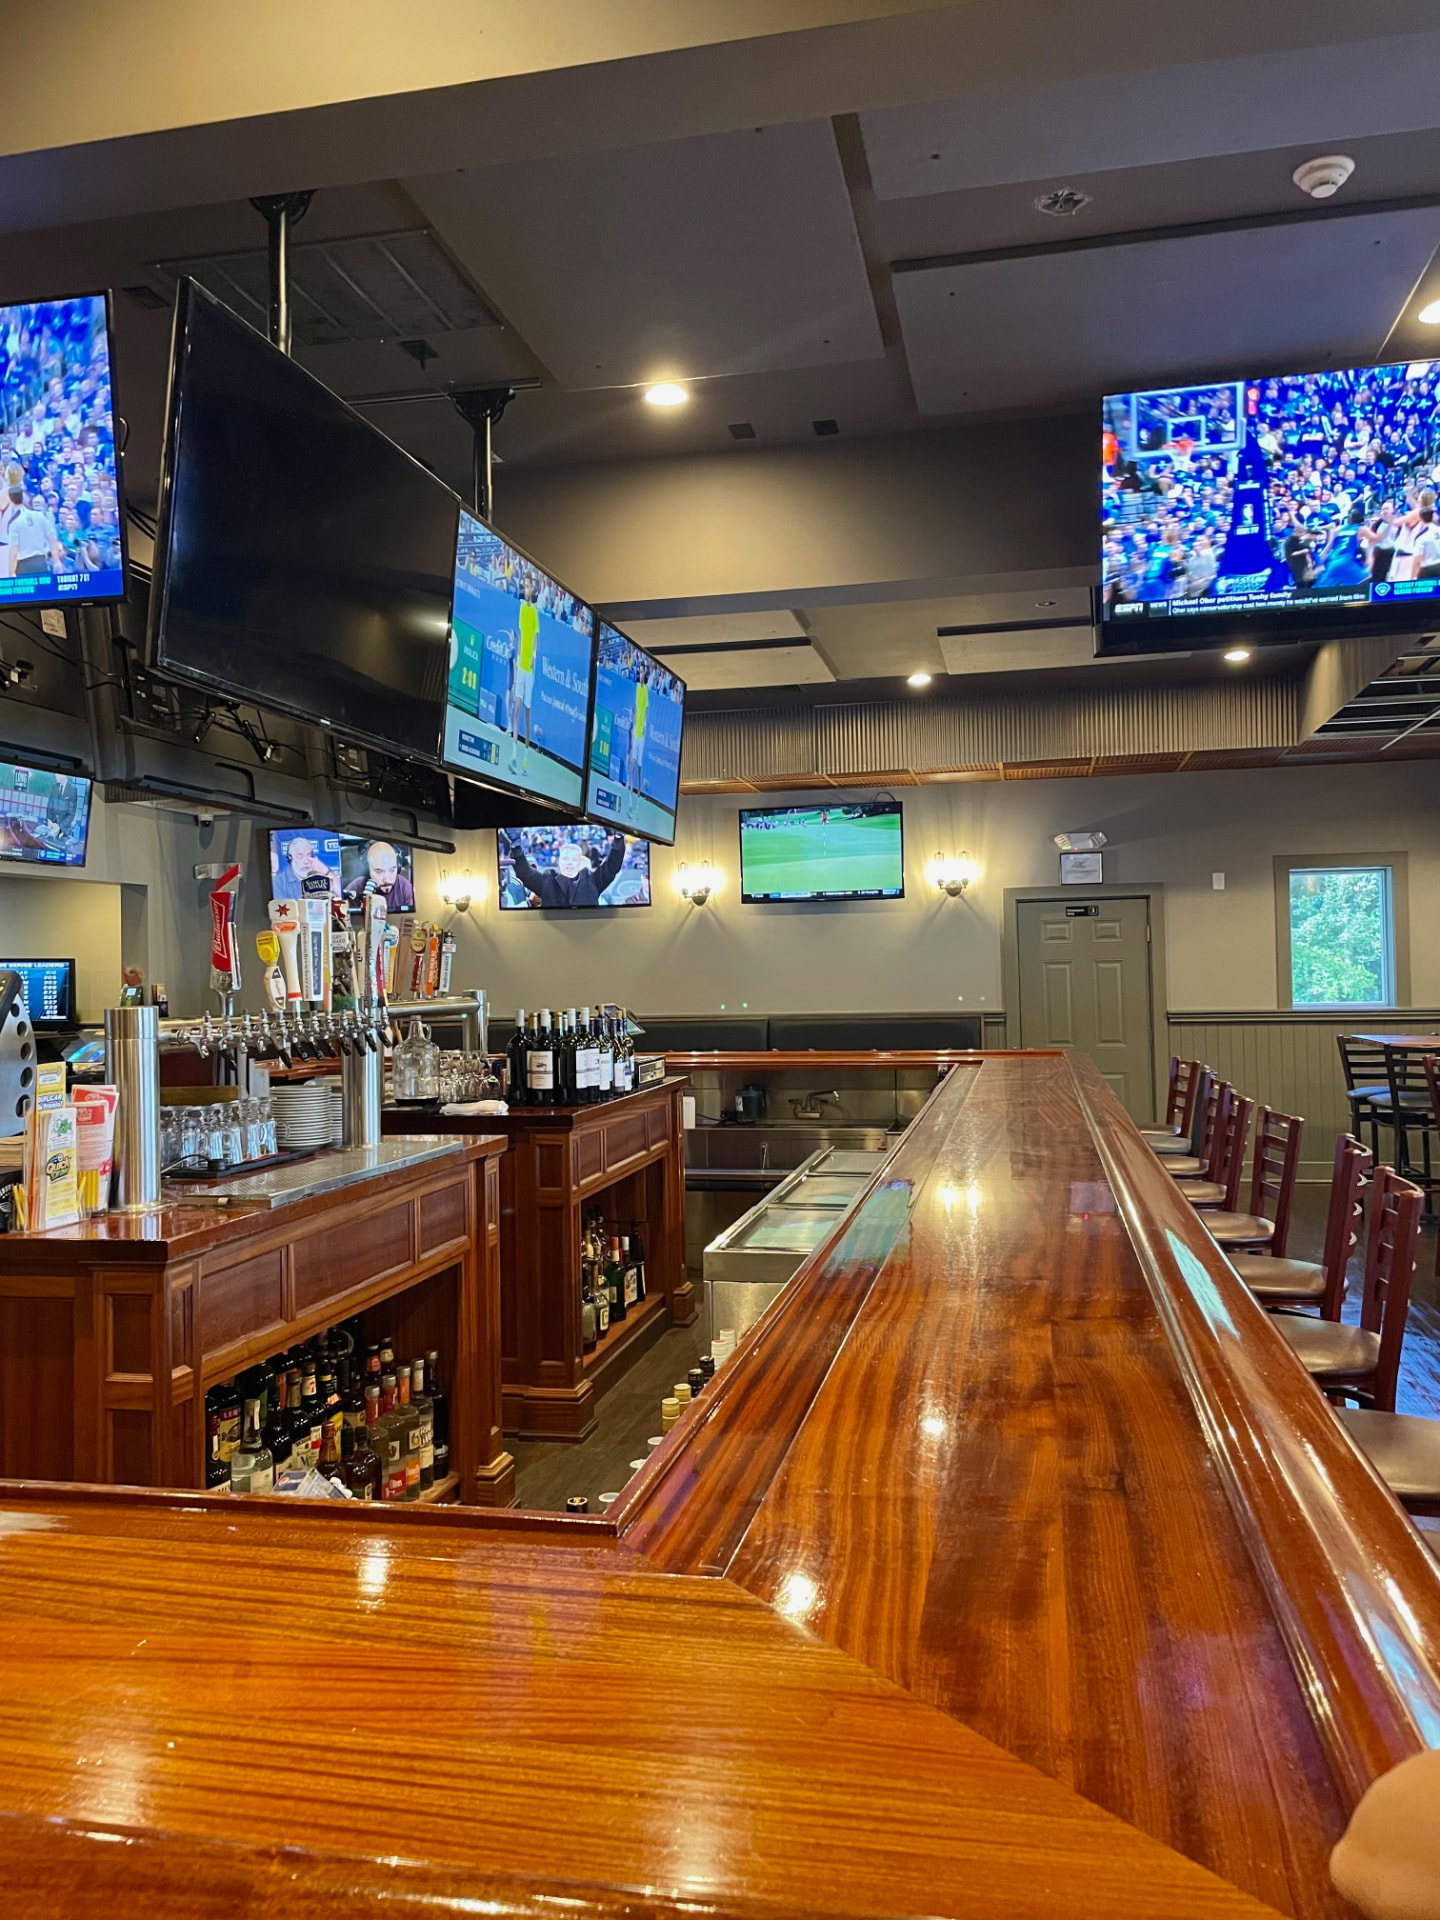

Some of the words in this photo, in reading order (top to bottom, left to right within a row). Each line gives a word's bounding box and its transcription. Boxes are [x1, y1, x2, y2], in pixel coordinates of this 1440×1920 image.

[1150, 601, 1167, 609] NEWS
[1172, 598, 1199, 607] Michael
[1216, 594, 1248, 605] petitions
[1269, 591, 1292, 600] family
[1114, 602, 1143, 614] ESPN
[1199, 602, 1243, 613] conservatorship
[542, 655, 566, 684] Western
[305, 879, 329, 887] SAMUEL
[213, 901, 222, 952] Budweiser
